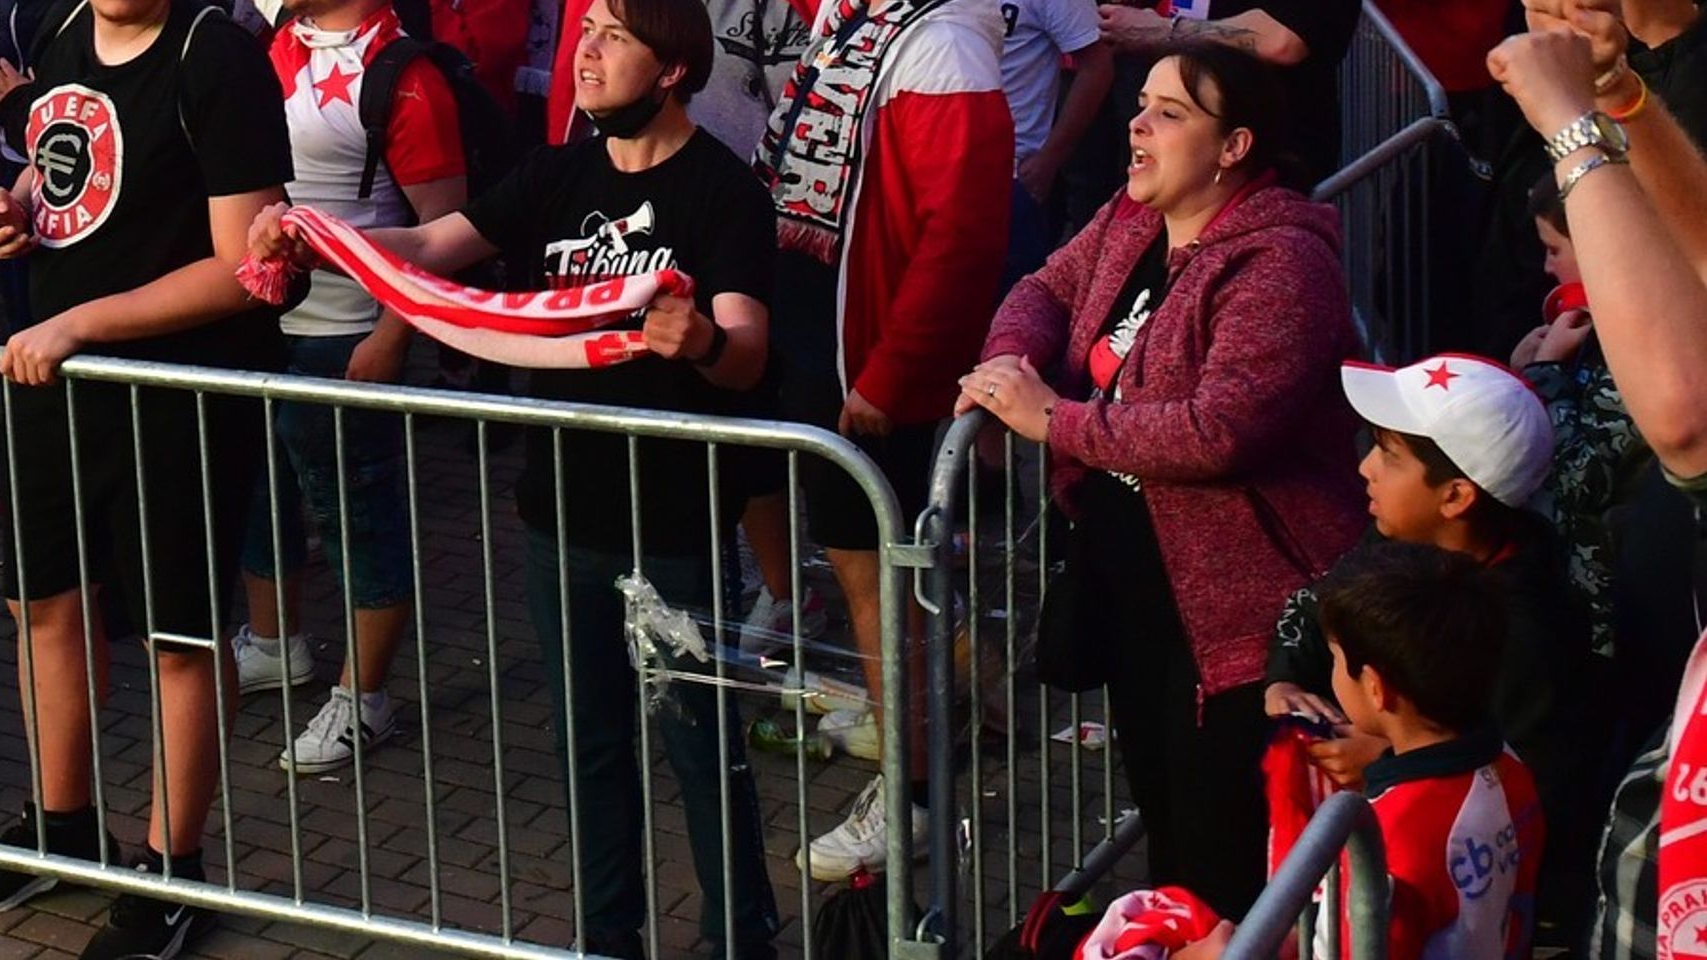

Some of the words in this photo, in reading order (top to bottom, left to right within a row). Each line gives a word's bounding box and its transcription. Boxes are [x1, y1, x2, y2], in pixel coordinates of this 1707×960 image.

[40, 96, 108, 142] UEFA
[35, 204, 93, 236] AFIA
[544, 233, 678, 284] Tribuna
